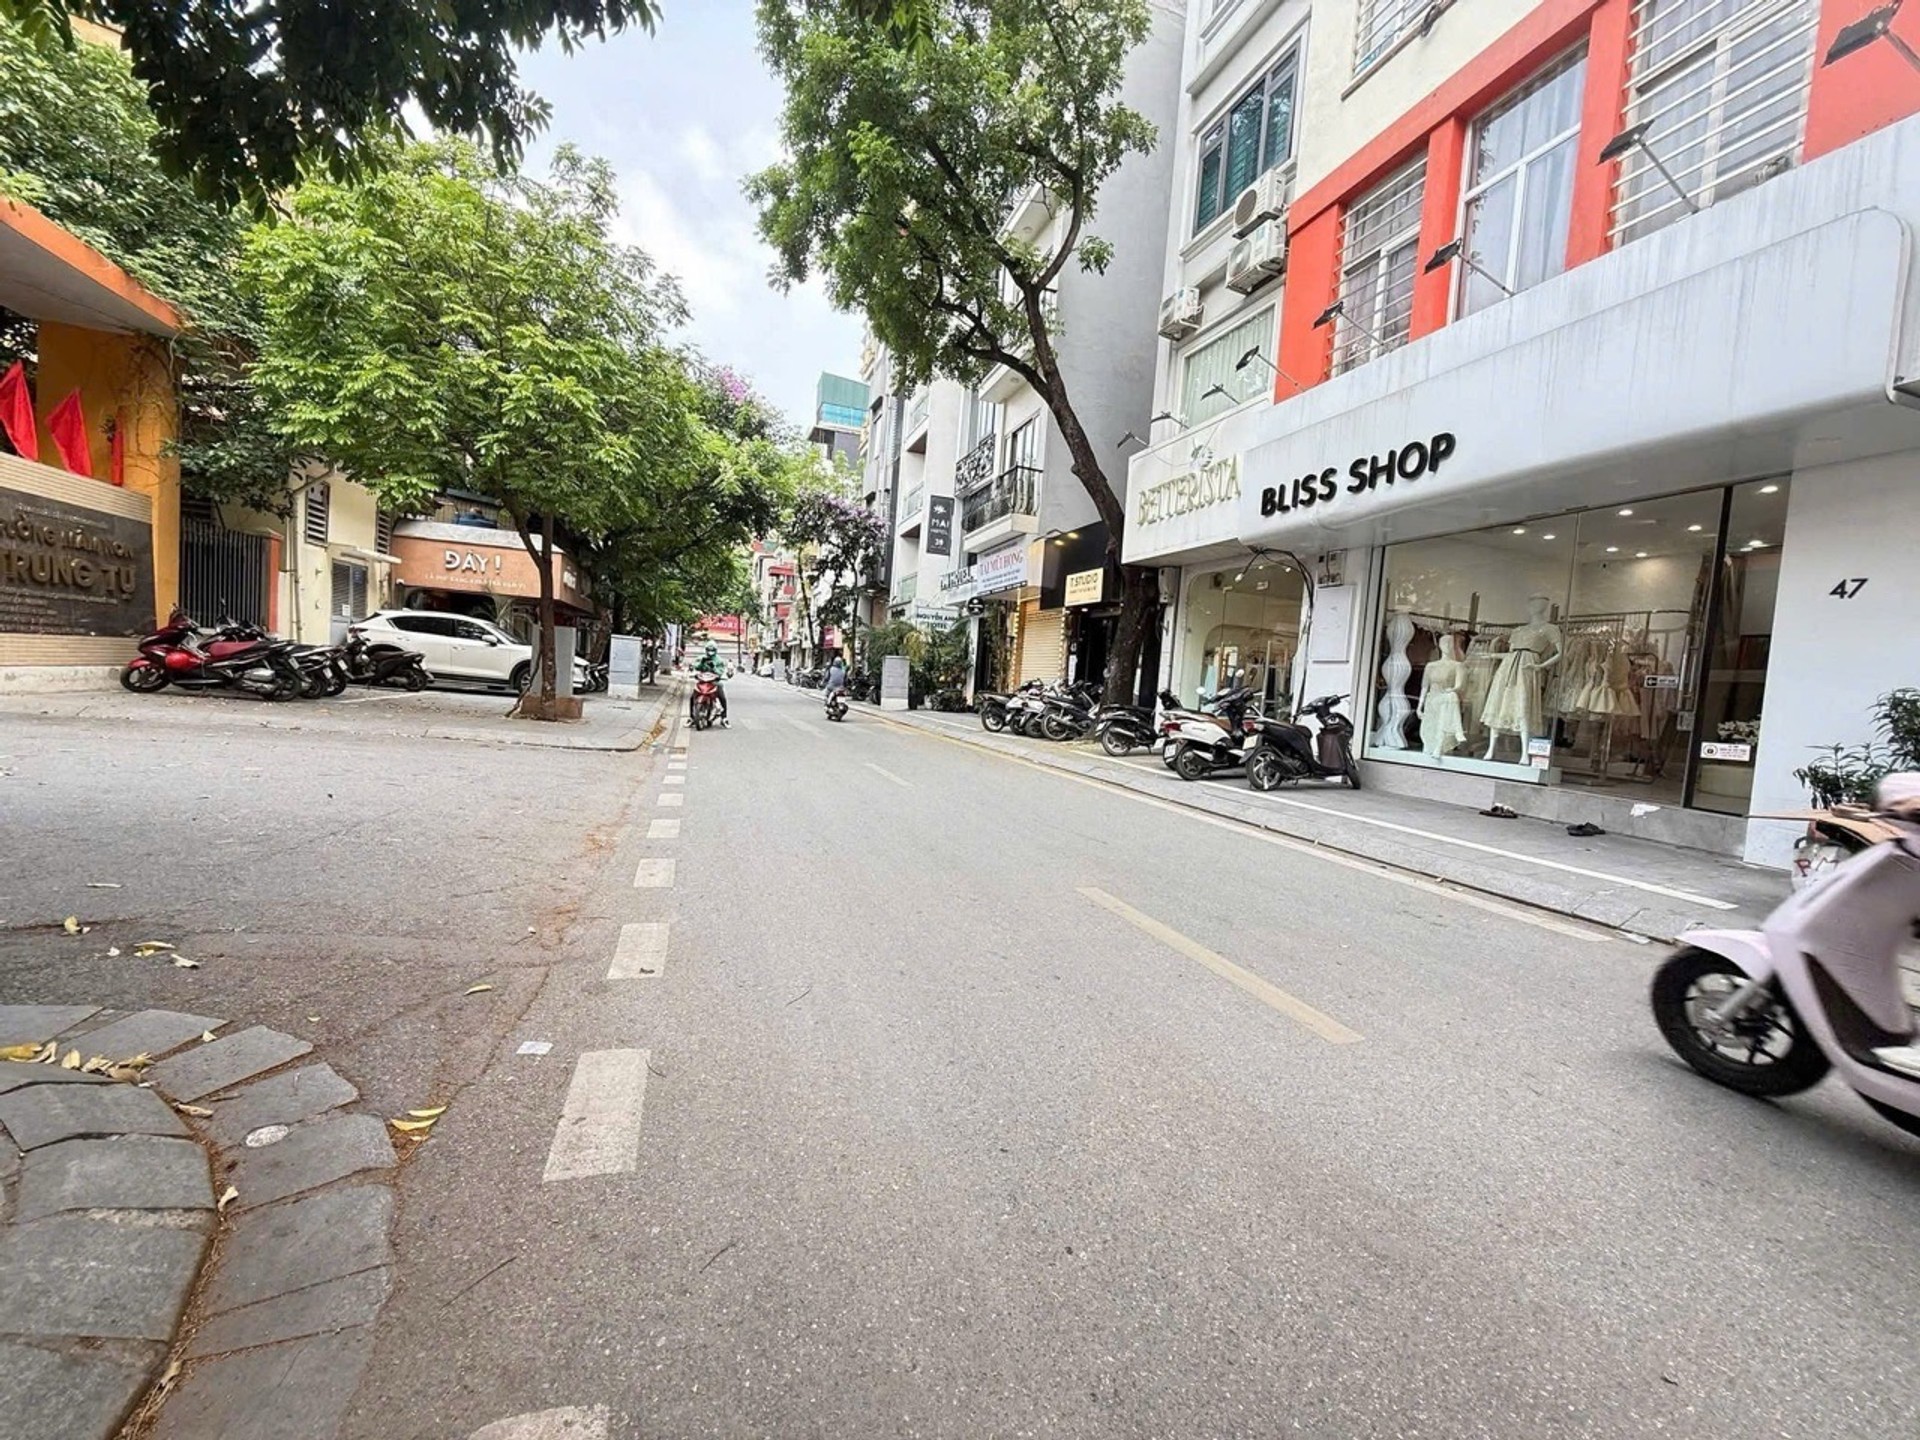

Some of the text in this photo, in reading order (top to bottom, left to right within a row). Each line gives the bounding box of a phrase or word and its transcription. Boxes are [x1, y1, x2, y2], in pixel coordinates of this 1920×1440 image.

[1261, 432, 1456, 517] BLISS SHOP
[931, 518, 950, 528] MAI
[1828, 577, 1869, 600] 47
